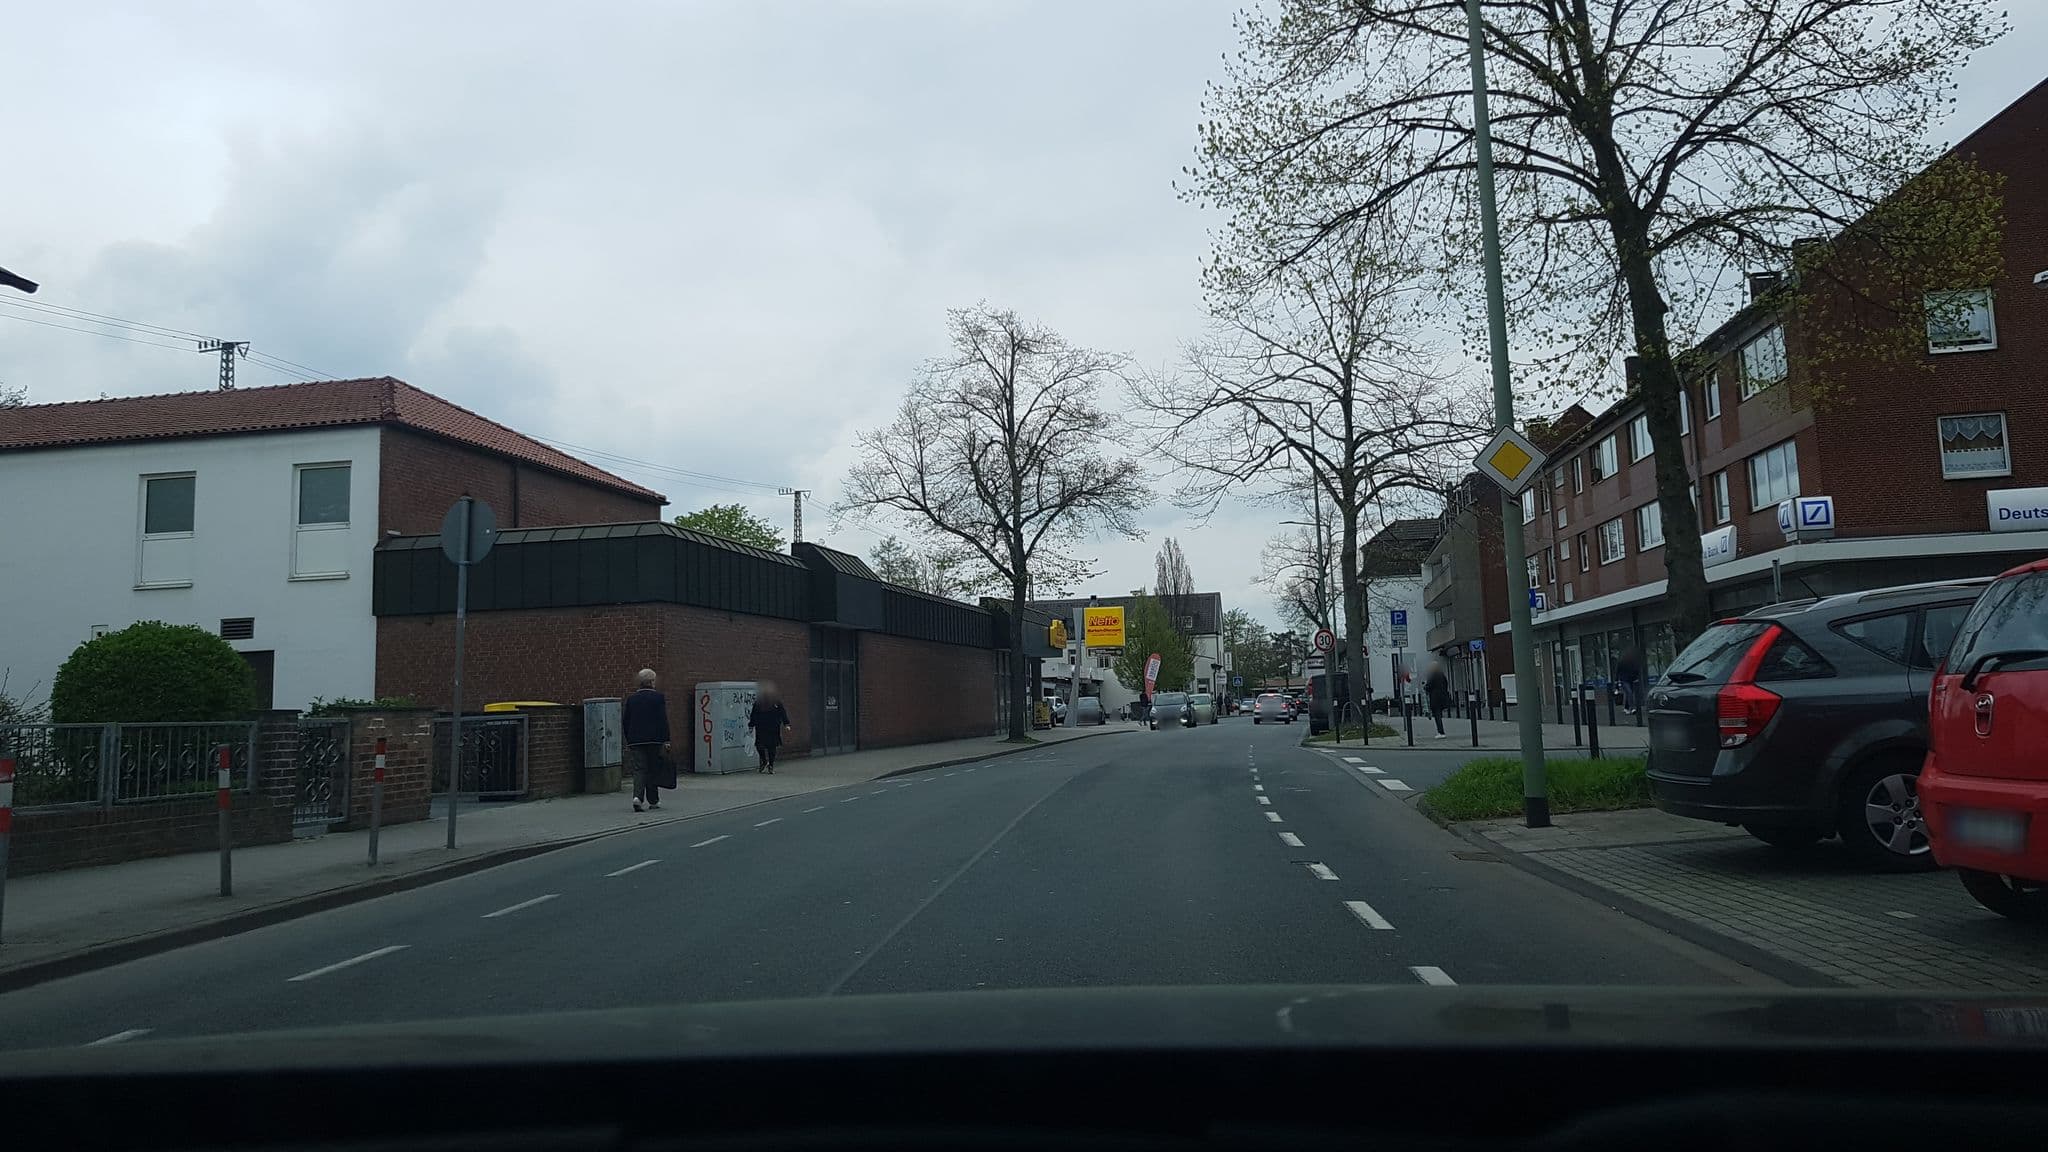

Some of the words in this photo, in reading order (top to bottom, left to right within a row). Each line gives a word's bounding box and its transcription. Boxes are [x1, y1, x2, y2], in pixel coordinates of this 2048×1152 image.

[1999, 507, 2048, 520] Deuts
[1089, 615, 1120, 627] Netto
[1394, 613, 1403, 624] P
[1319, 635, 1331, 646] 30
